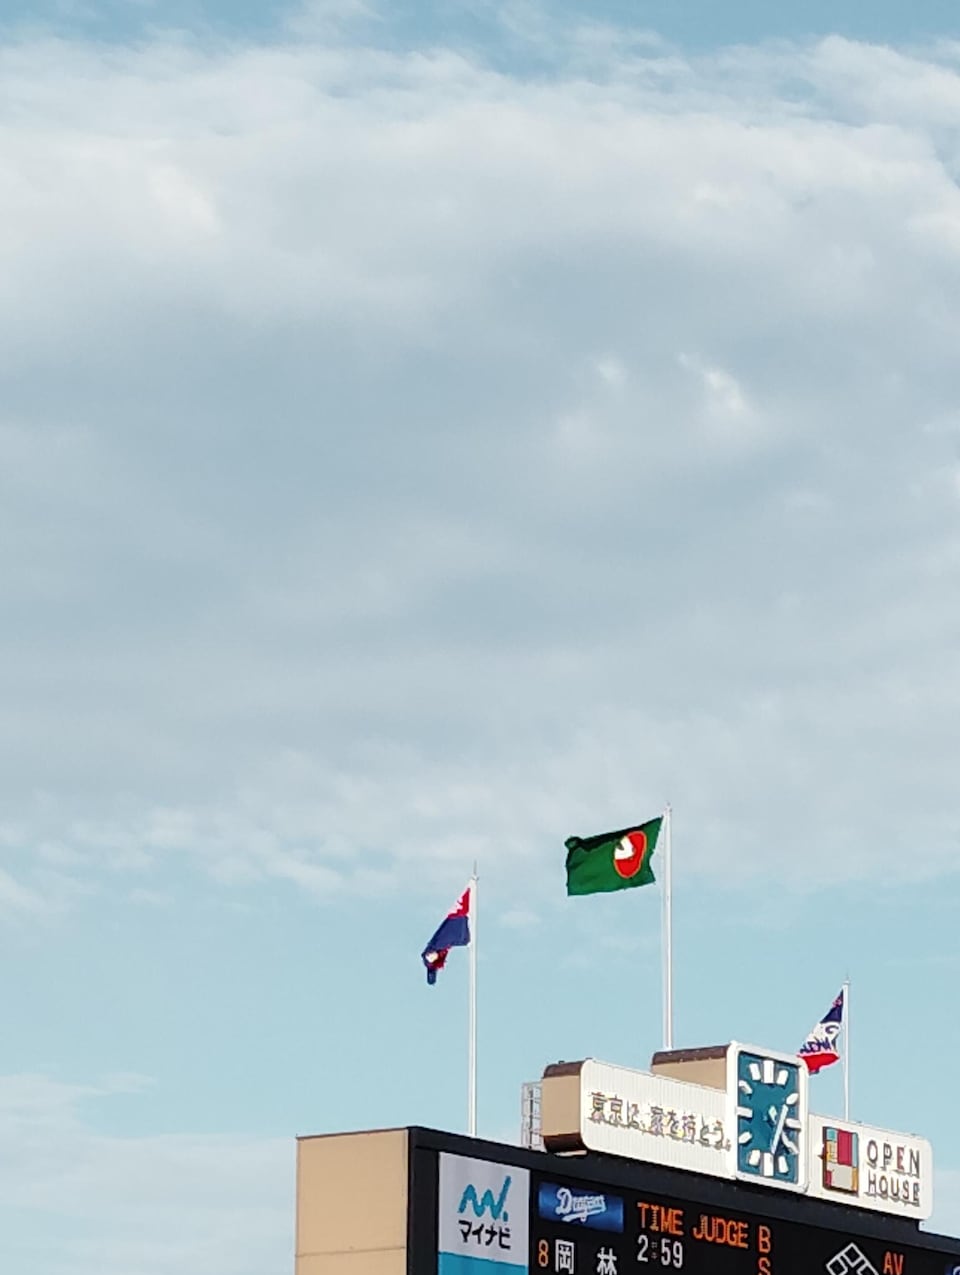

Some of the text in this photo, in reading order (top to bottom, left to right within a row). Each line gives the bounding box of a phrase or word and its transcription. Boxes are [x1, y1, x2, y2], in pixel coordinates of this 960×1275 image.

[867, 1140, 920, 1177] OPEN
[867, 1173, 920, 1206] HOUSE
[459, 1220, 512, 1250] マイナビ
[637, 1202, 749, 1248] TIME JUDGE
[758, 1226, 771, 1253] B
[538, 1239, 548, 1268] 8
[637, 1235, 683, 1269] 2:59
